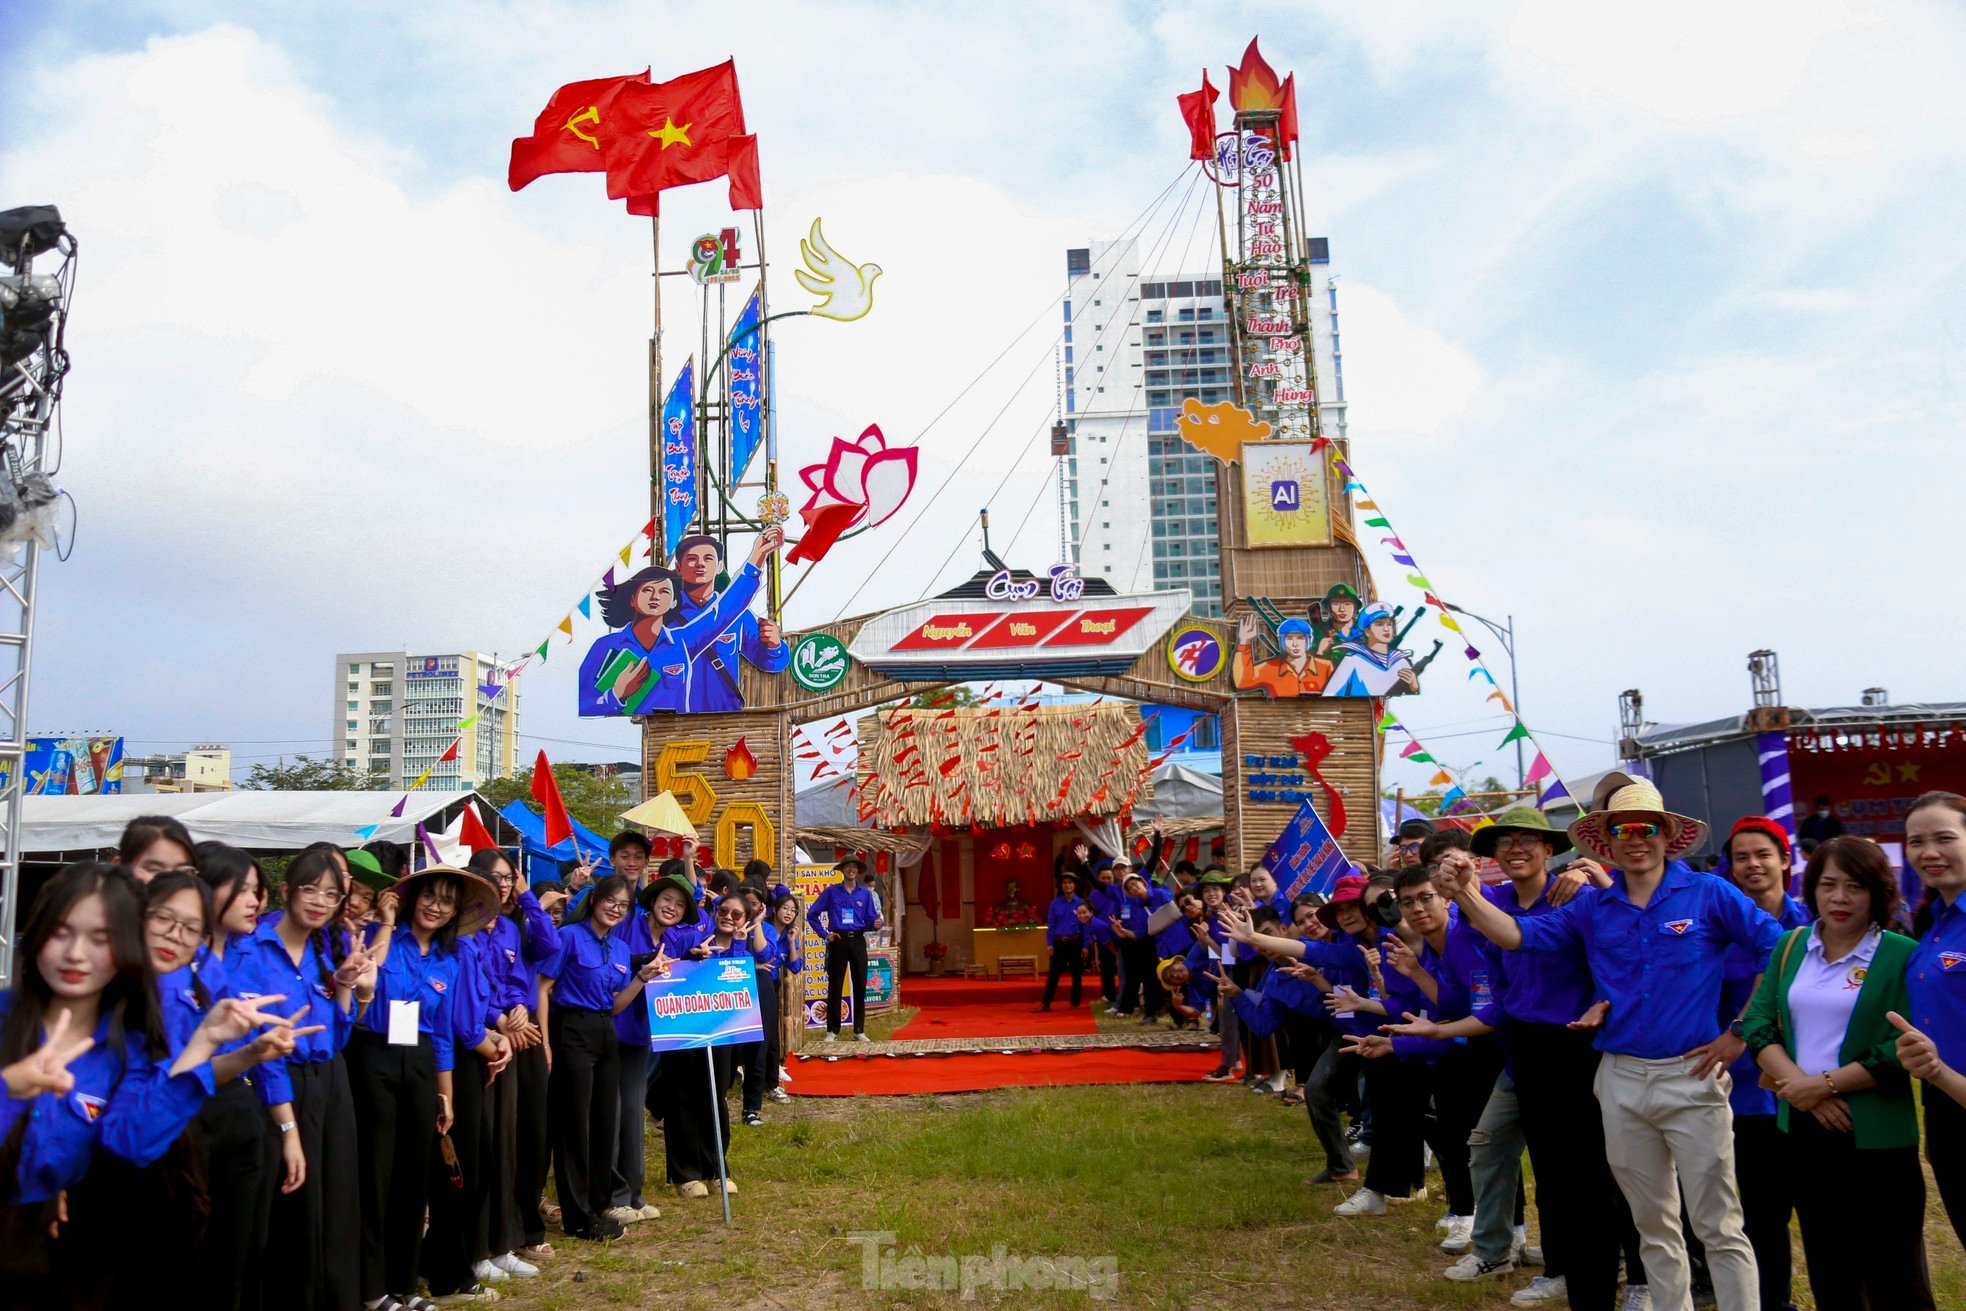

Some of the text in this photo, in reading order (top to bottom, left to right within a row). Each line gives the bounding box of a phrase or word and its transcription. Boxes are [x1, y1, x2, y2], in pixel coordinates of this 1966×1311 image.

[1252, 172, 1274, 189] 50
[1247, 200, 1284, 215] Năm
[1255, 220, 1276, 237] Tự
[1250, 239, 1282, 256] Hào
[1237, 268, 1269, 288] Tuổi
[1274, 282, 1300, 300] Trẻ
[1247, 317, 1290, 333] Thành
[1270, 335, 1300, 351] Phố
[1249, 363, 1280, 377] Anh
[1273, 387, 1314, 403] Hùng
[1273, 485, 1296, 505] AI
[986, 563, 1084, 603] Cụm Trại
[922, 619, 1115, 640] Nguyễn Văn Thoại
[406, 670, 459, 679] PETROLIMEX
[655, 986, 752, 1019] QUẬN ĐOÀN SƠN TRÀ
